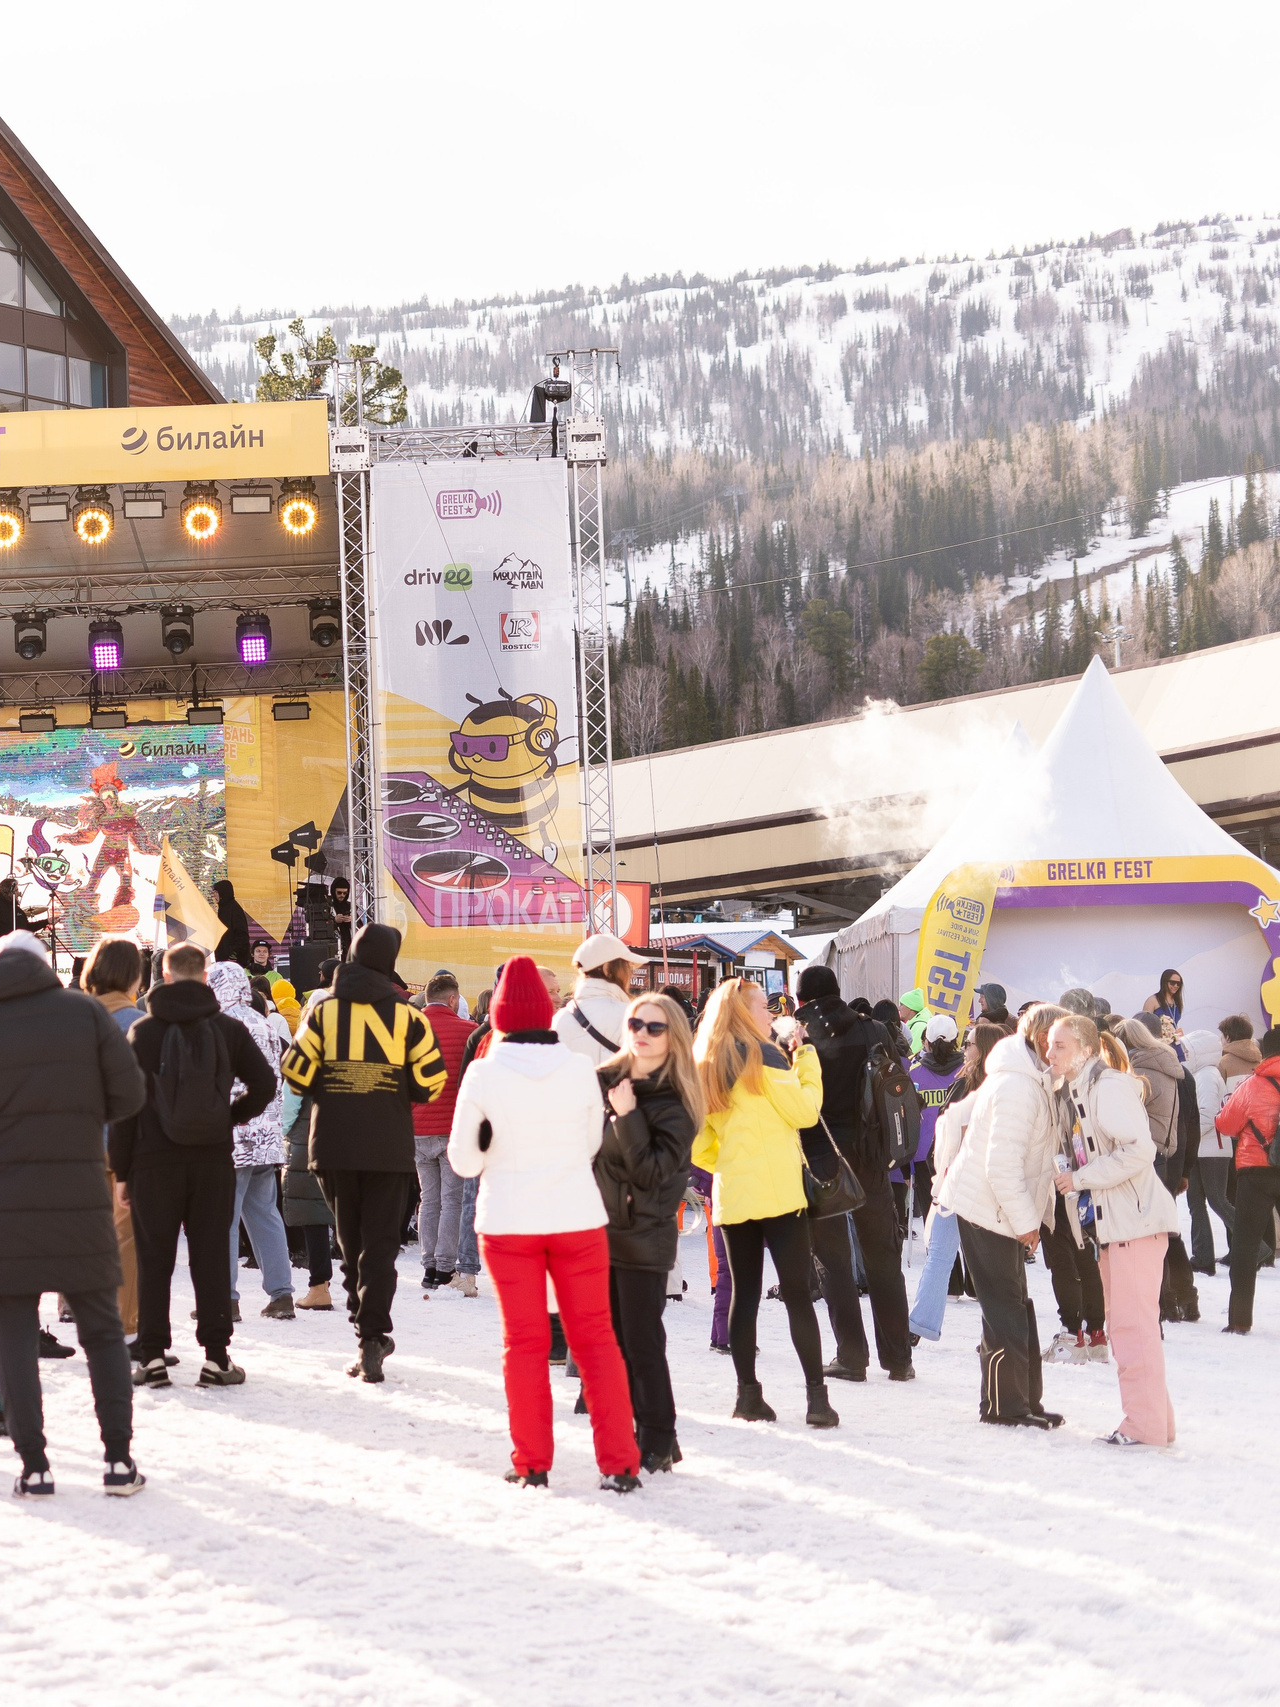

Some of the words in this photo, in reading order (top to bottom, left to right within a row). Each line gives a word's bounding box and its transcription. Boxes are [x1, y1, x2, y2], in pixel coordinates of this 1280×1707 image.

[157, 423, 264, 451] билайн
[442, 493, 474, 504] GRELKA
[443, 505, 464, 515] FEST
[404, 568, 472, 586] drivee
[493, 571, 543, 581] MOUNTAIN
[521, 580, 544, 590] MAN
[141, 741, 207, 757] билайн
[1047, 861, 1106, 880] GRELKA
[1114, 860, 1153, 879] FEST
[434, 886, 581, 934] ПРОКАТ
[657, 972, 684, 985] ШОЛА
